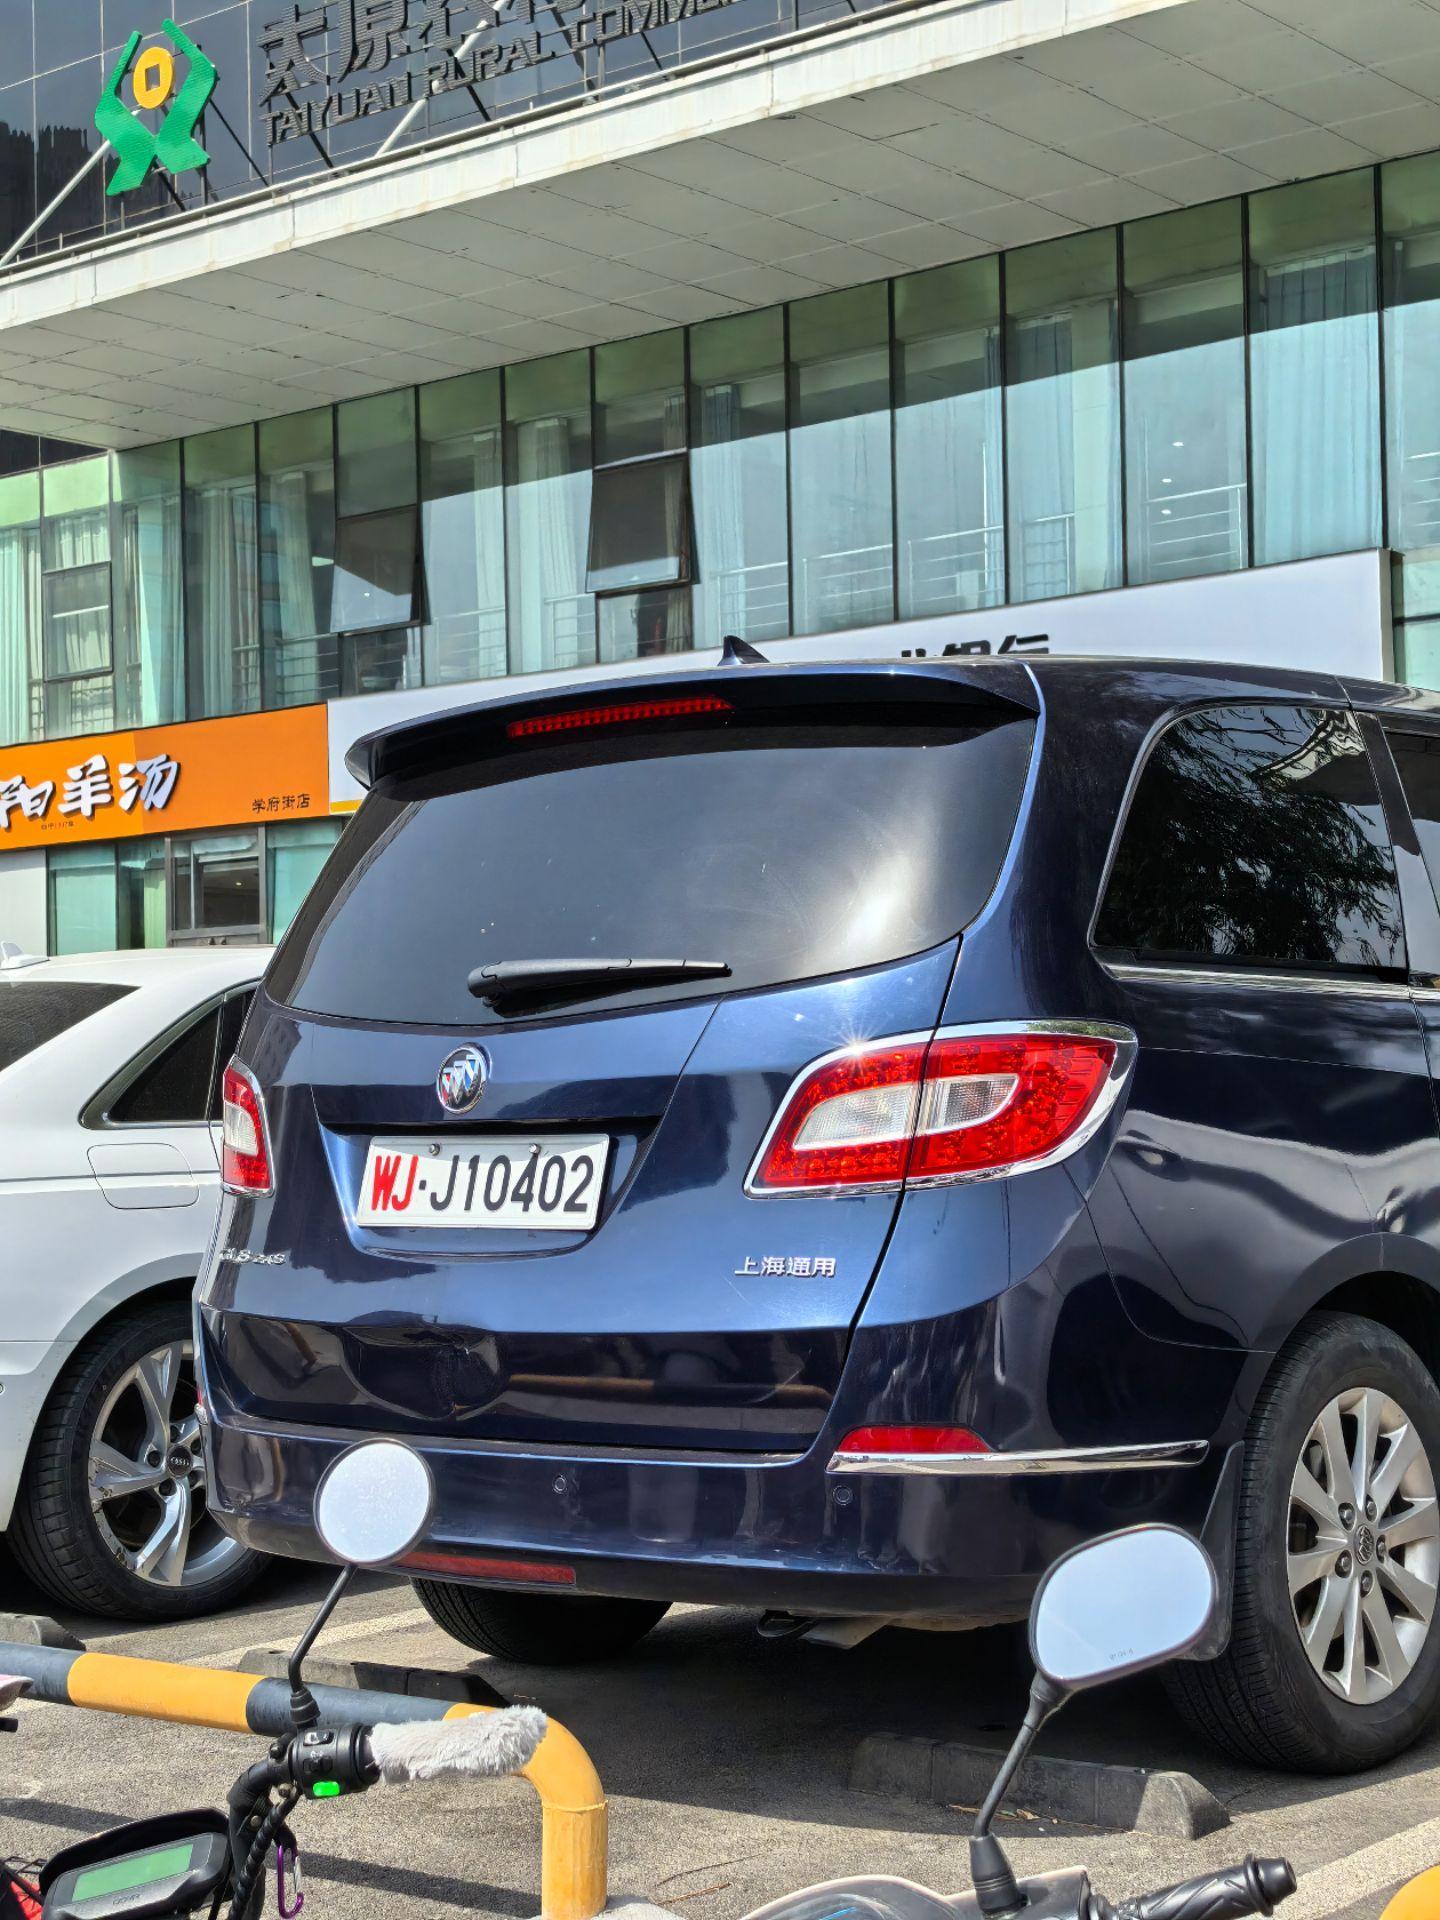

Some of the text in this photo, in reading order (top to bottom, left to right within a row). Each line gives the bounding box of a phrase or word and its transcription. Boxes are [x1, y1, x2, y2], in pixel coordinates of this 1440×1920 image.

[261, 71, 413, 147] TAIYUAN
[424, 32, 555, 97] RURAL
[252, 793, 311, 814] 学府街店
[734, 1256, 837, 1278] 上海通用
